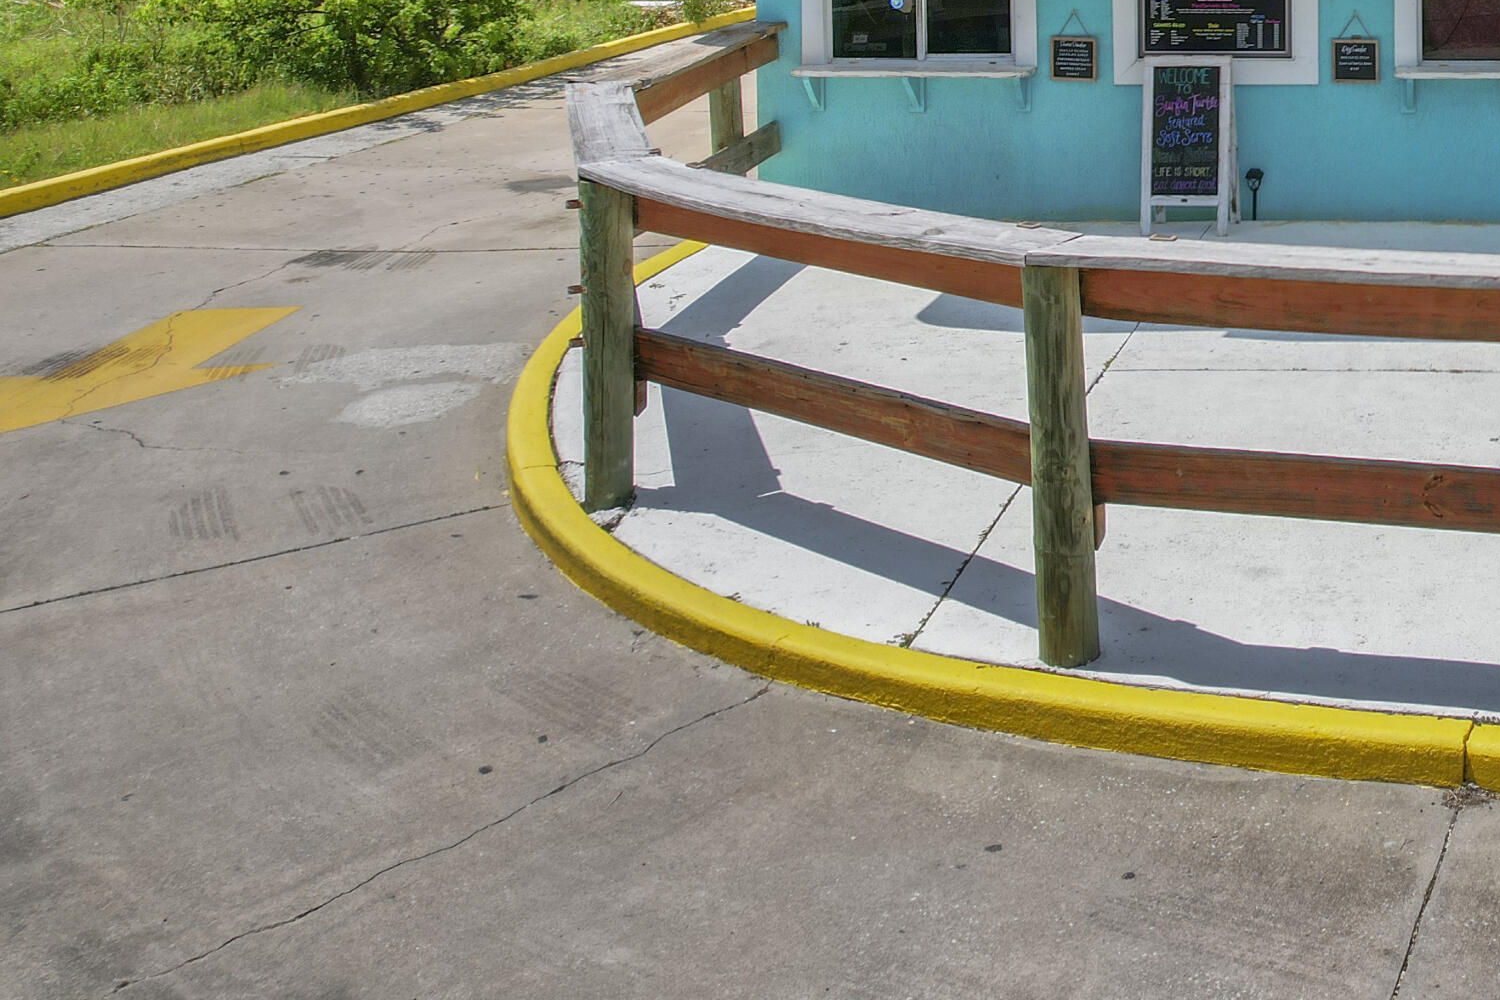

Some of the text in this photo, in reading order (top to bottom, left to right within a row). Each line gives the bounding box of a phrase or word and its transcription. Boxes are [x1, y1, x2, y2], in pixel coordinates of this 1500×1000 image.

[1160, 67, 1210, 85] WELCOME
[1175, 83, 1192, 95] TO
[1154, 166, 1172, 177] LIFE
